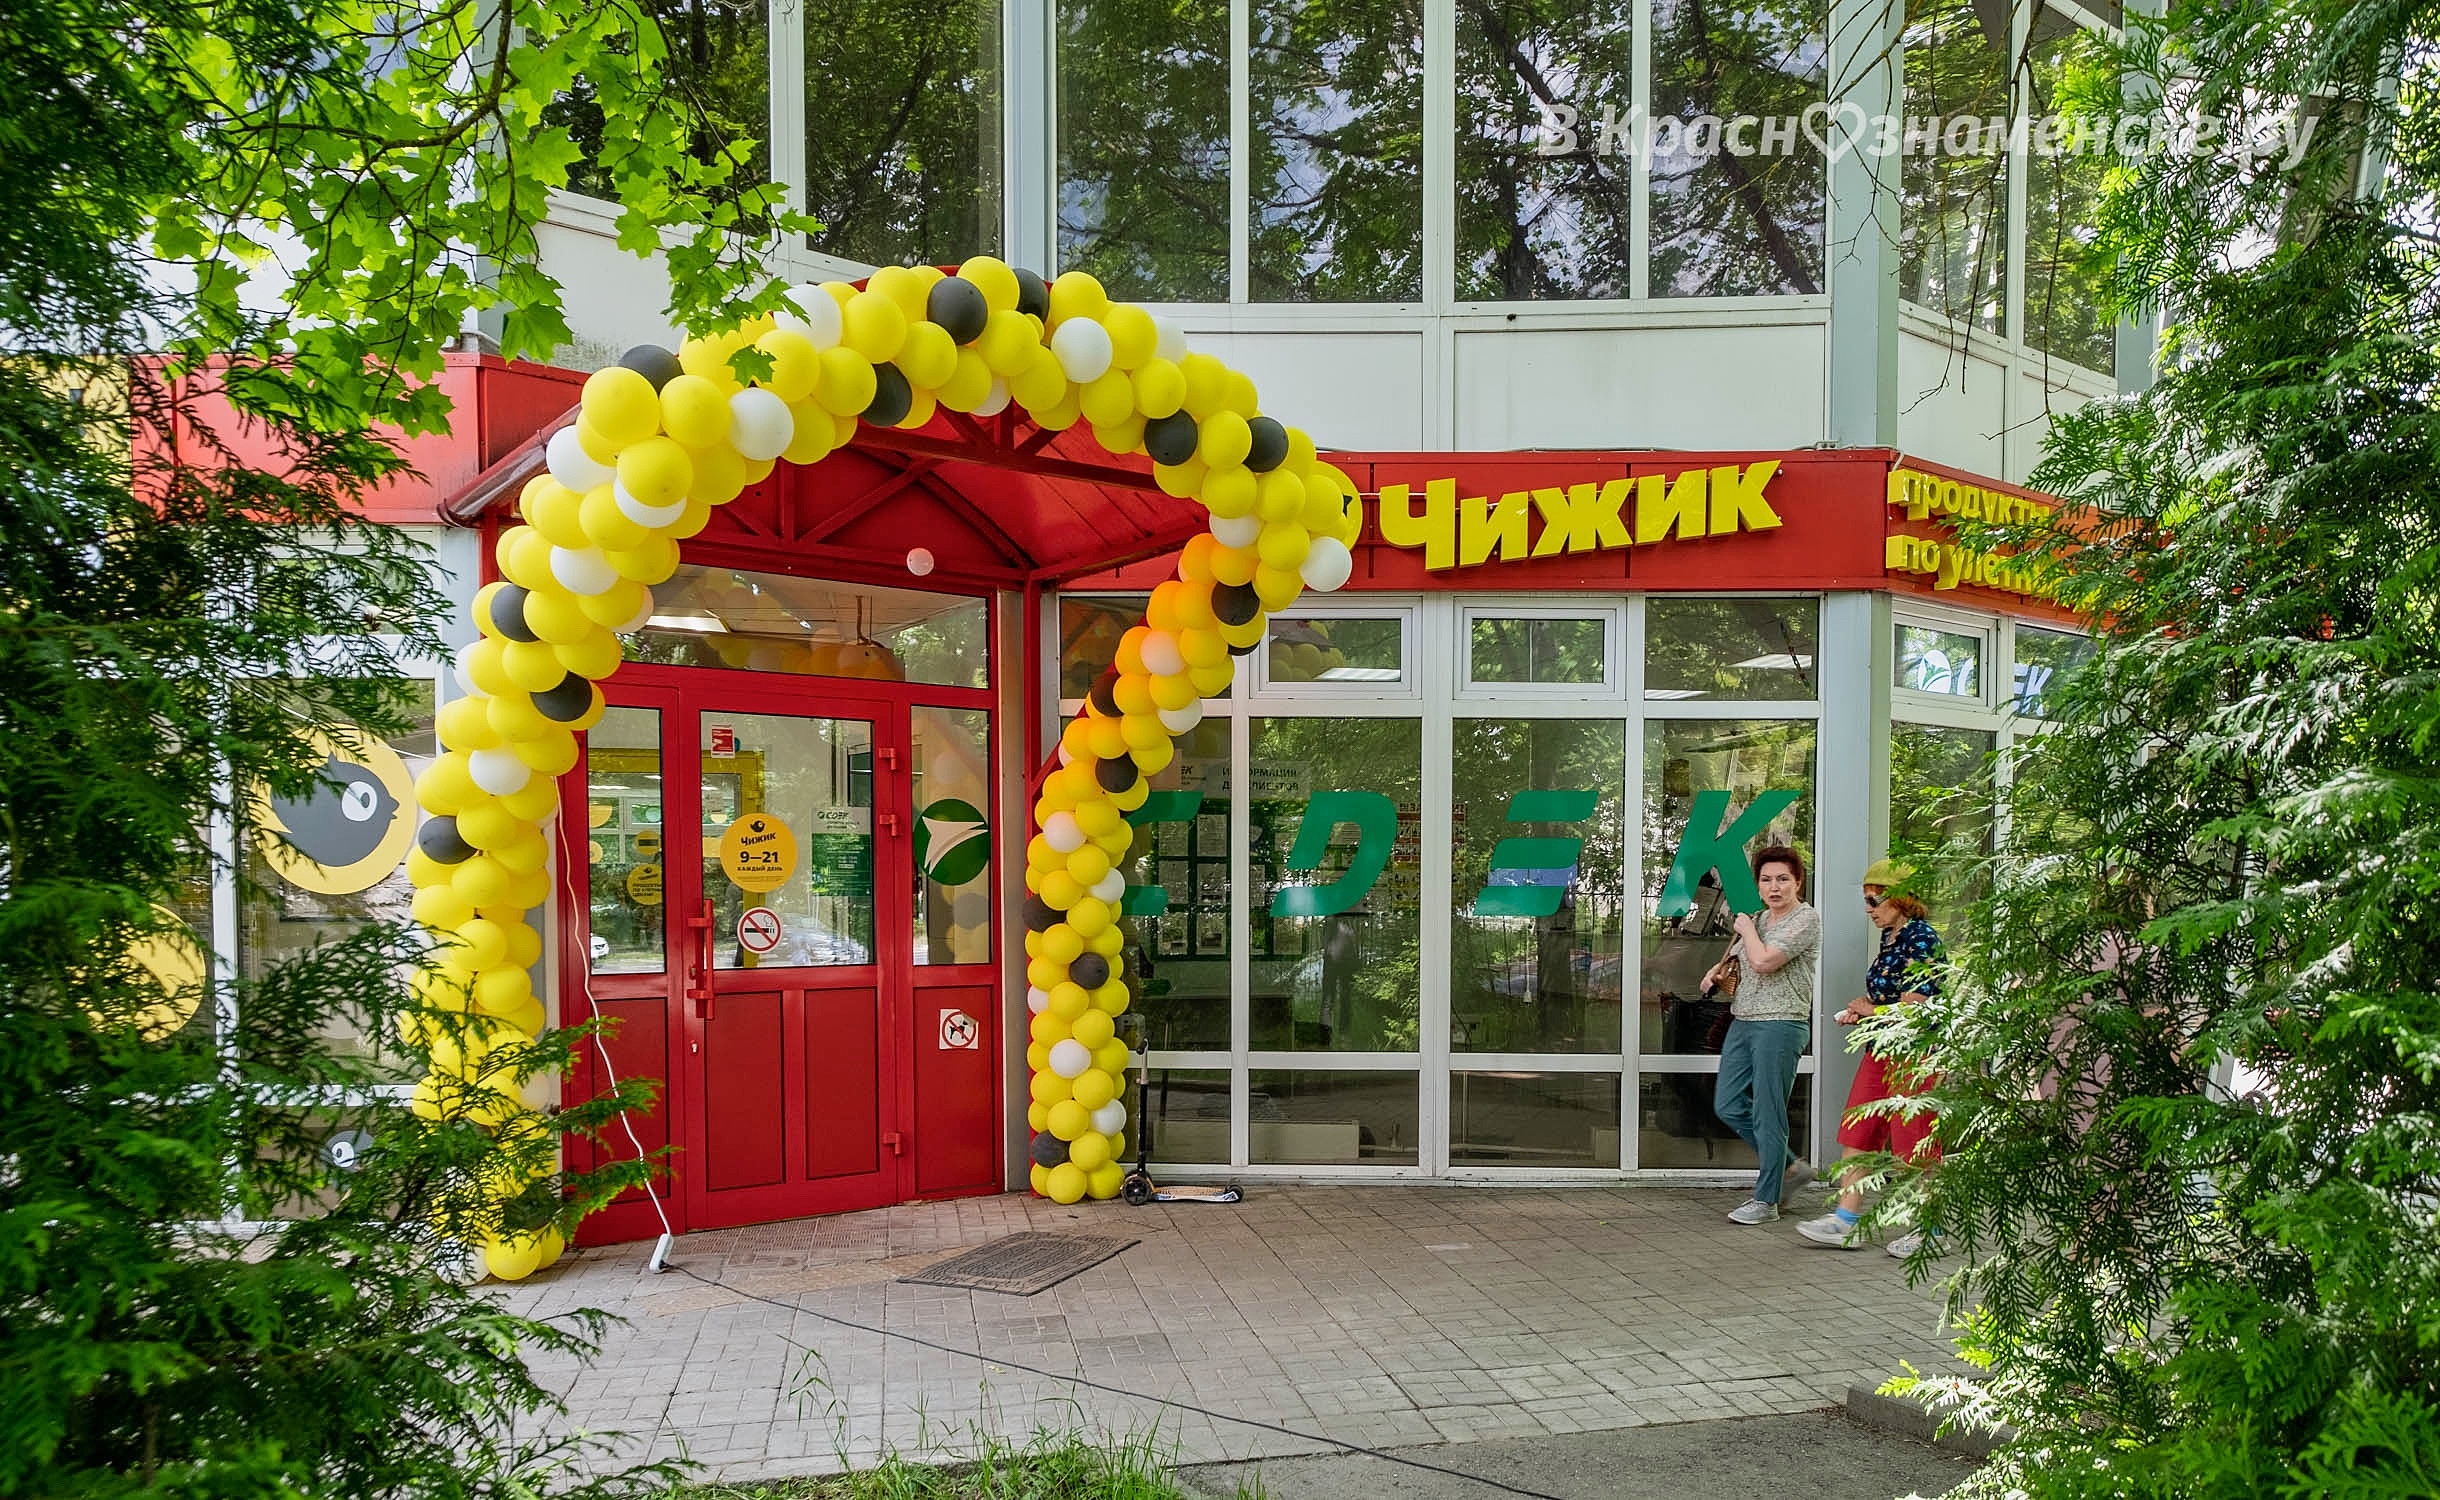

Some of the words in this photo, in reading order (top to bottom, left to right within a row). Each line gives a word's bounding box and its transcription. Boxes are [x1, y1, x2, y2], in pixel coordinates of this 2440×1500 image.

[1380, 459, 1783, 572] Чижик
[1888, 469, 2049, 525] продукты
[1886, 535, 1941, 574] по
